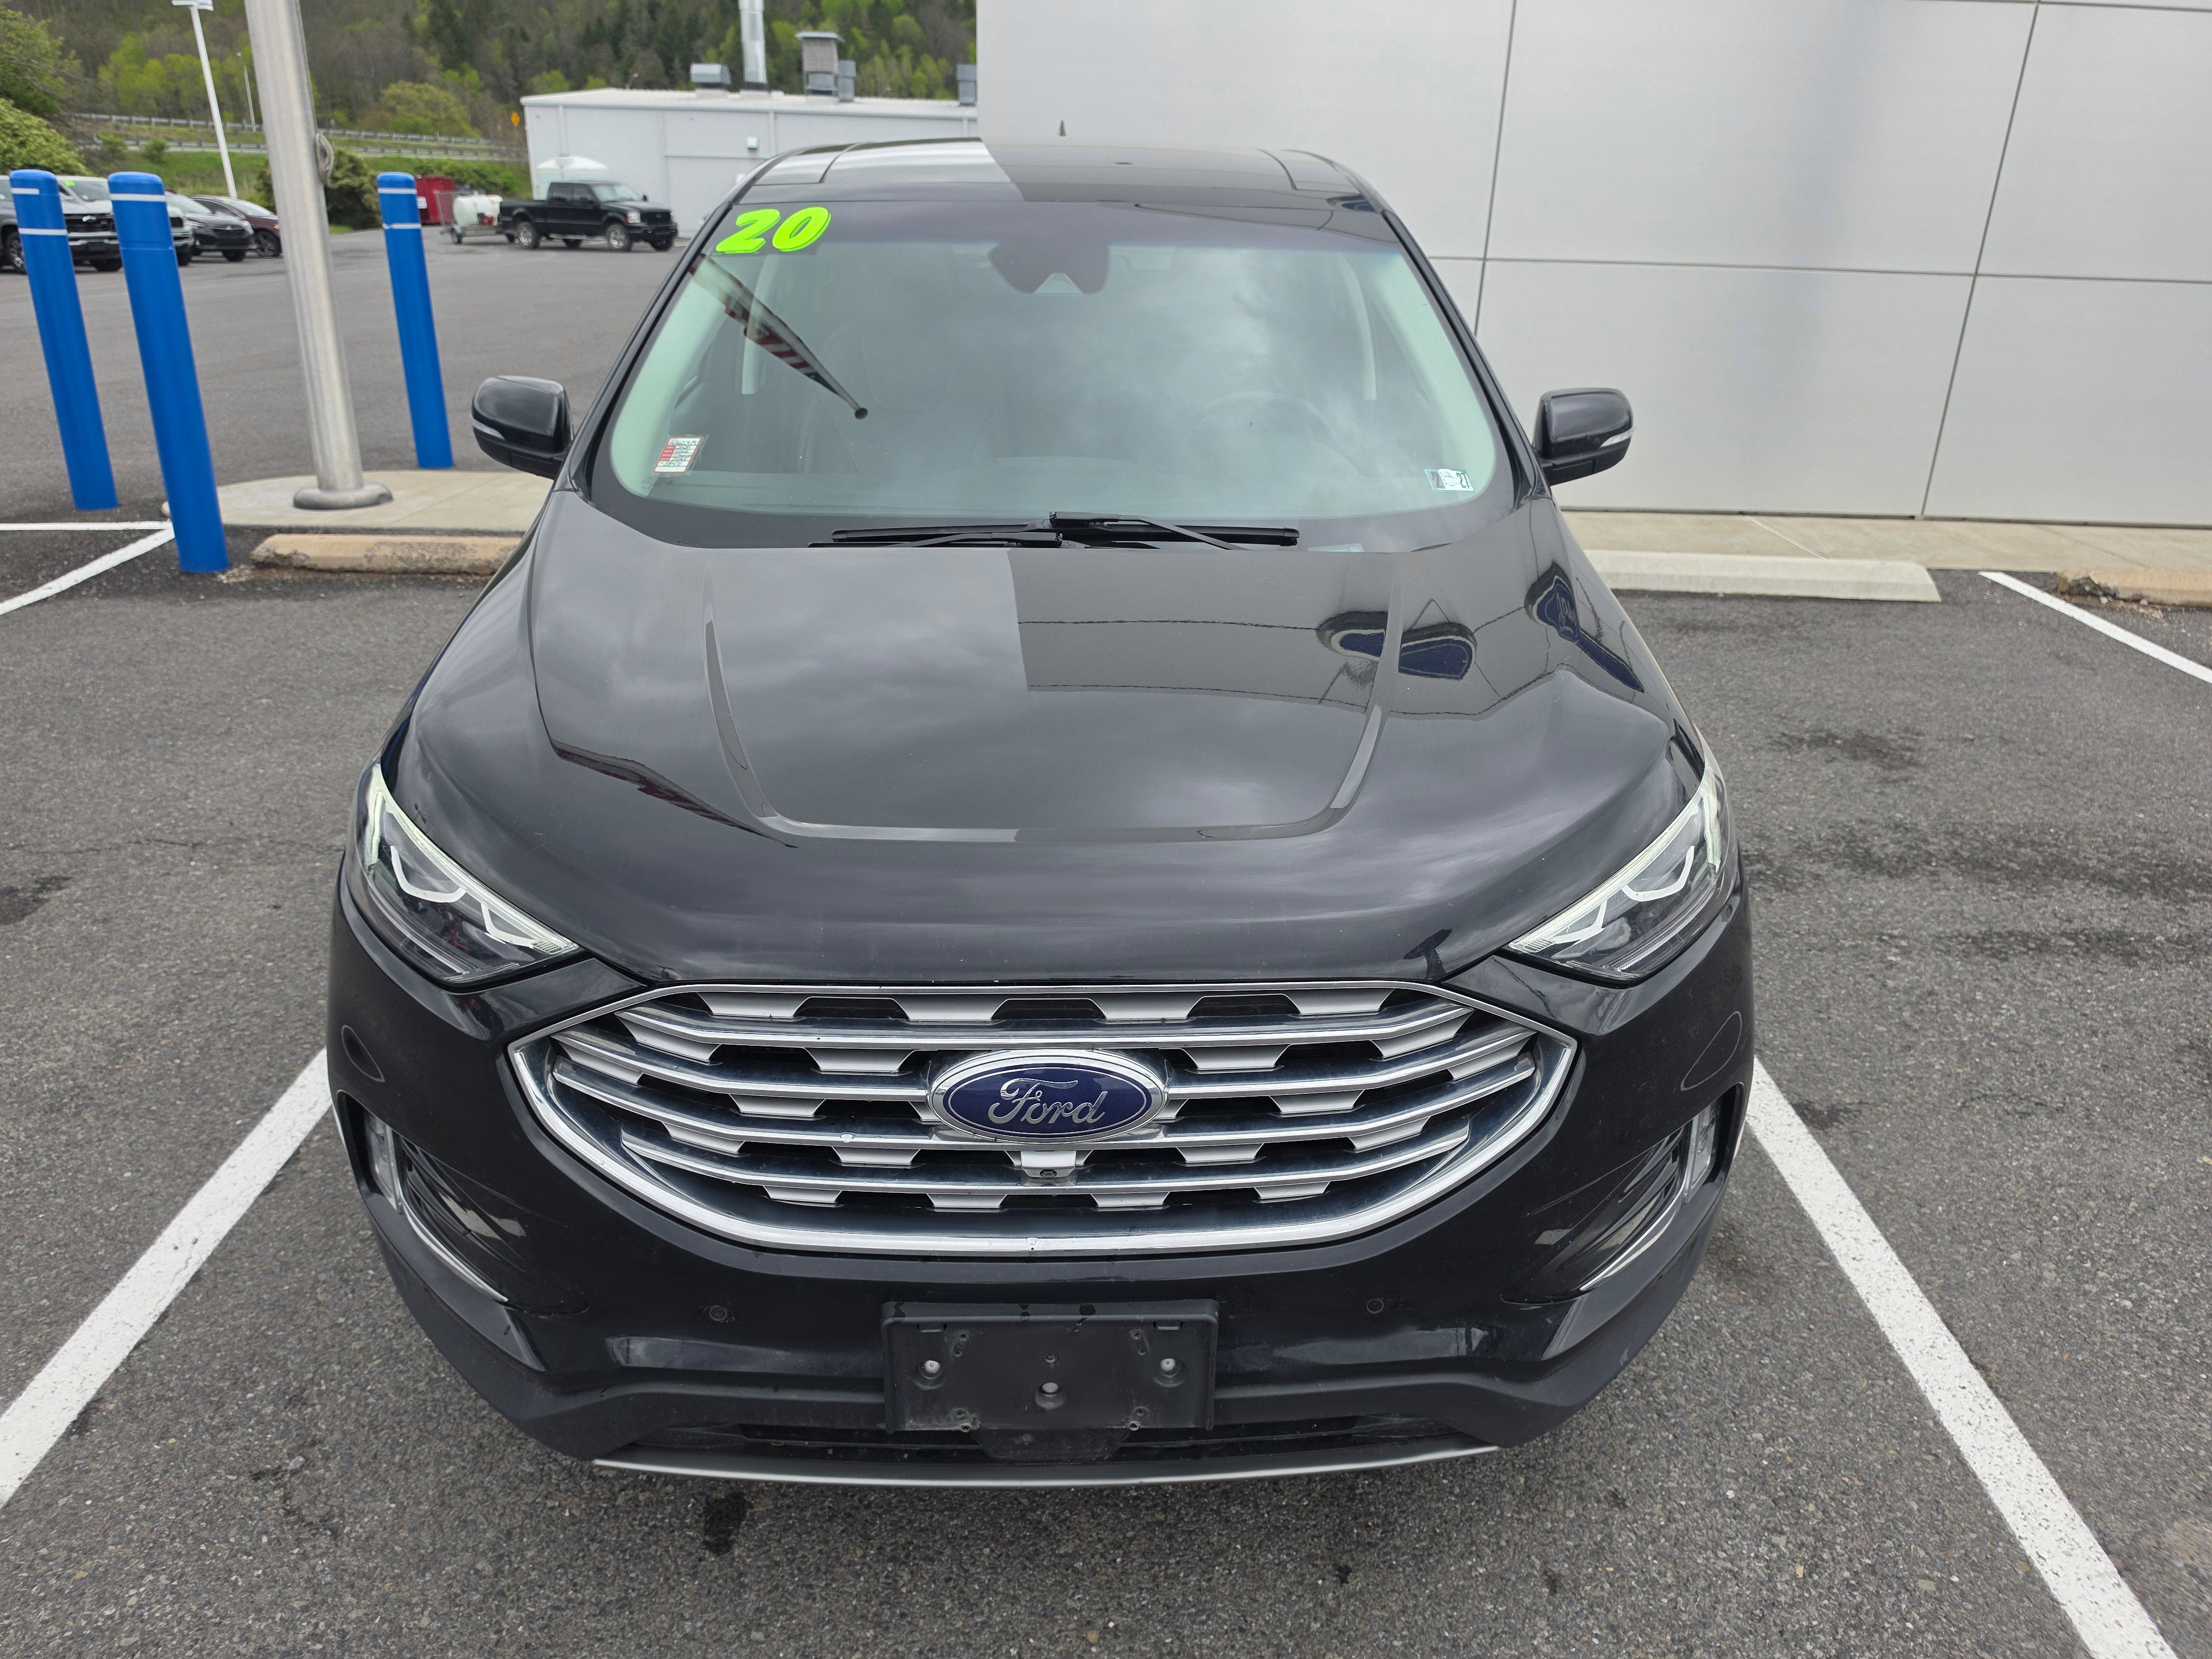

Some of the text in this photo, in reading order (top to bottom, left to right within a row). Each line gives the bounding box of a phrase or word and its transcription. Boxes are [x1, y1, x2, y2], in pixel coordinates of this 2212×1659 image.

[716, 206, 831, 254] 20
[1456, 472, 1470, 489] 27
[988, 1078, 1108, 1124] Ford
